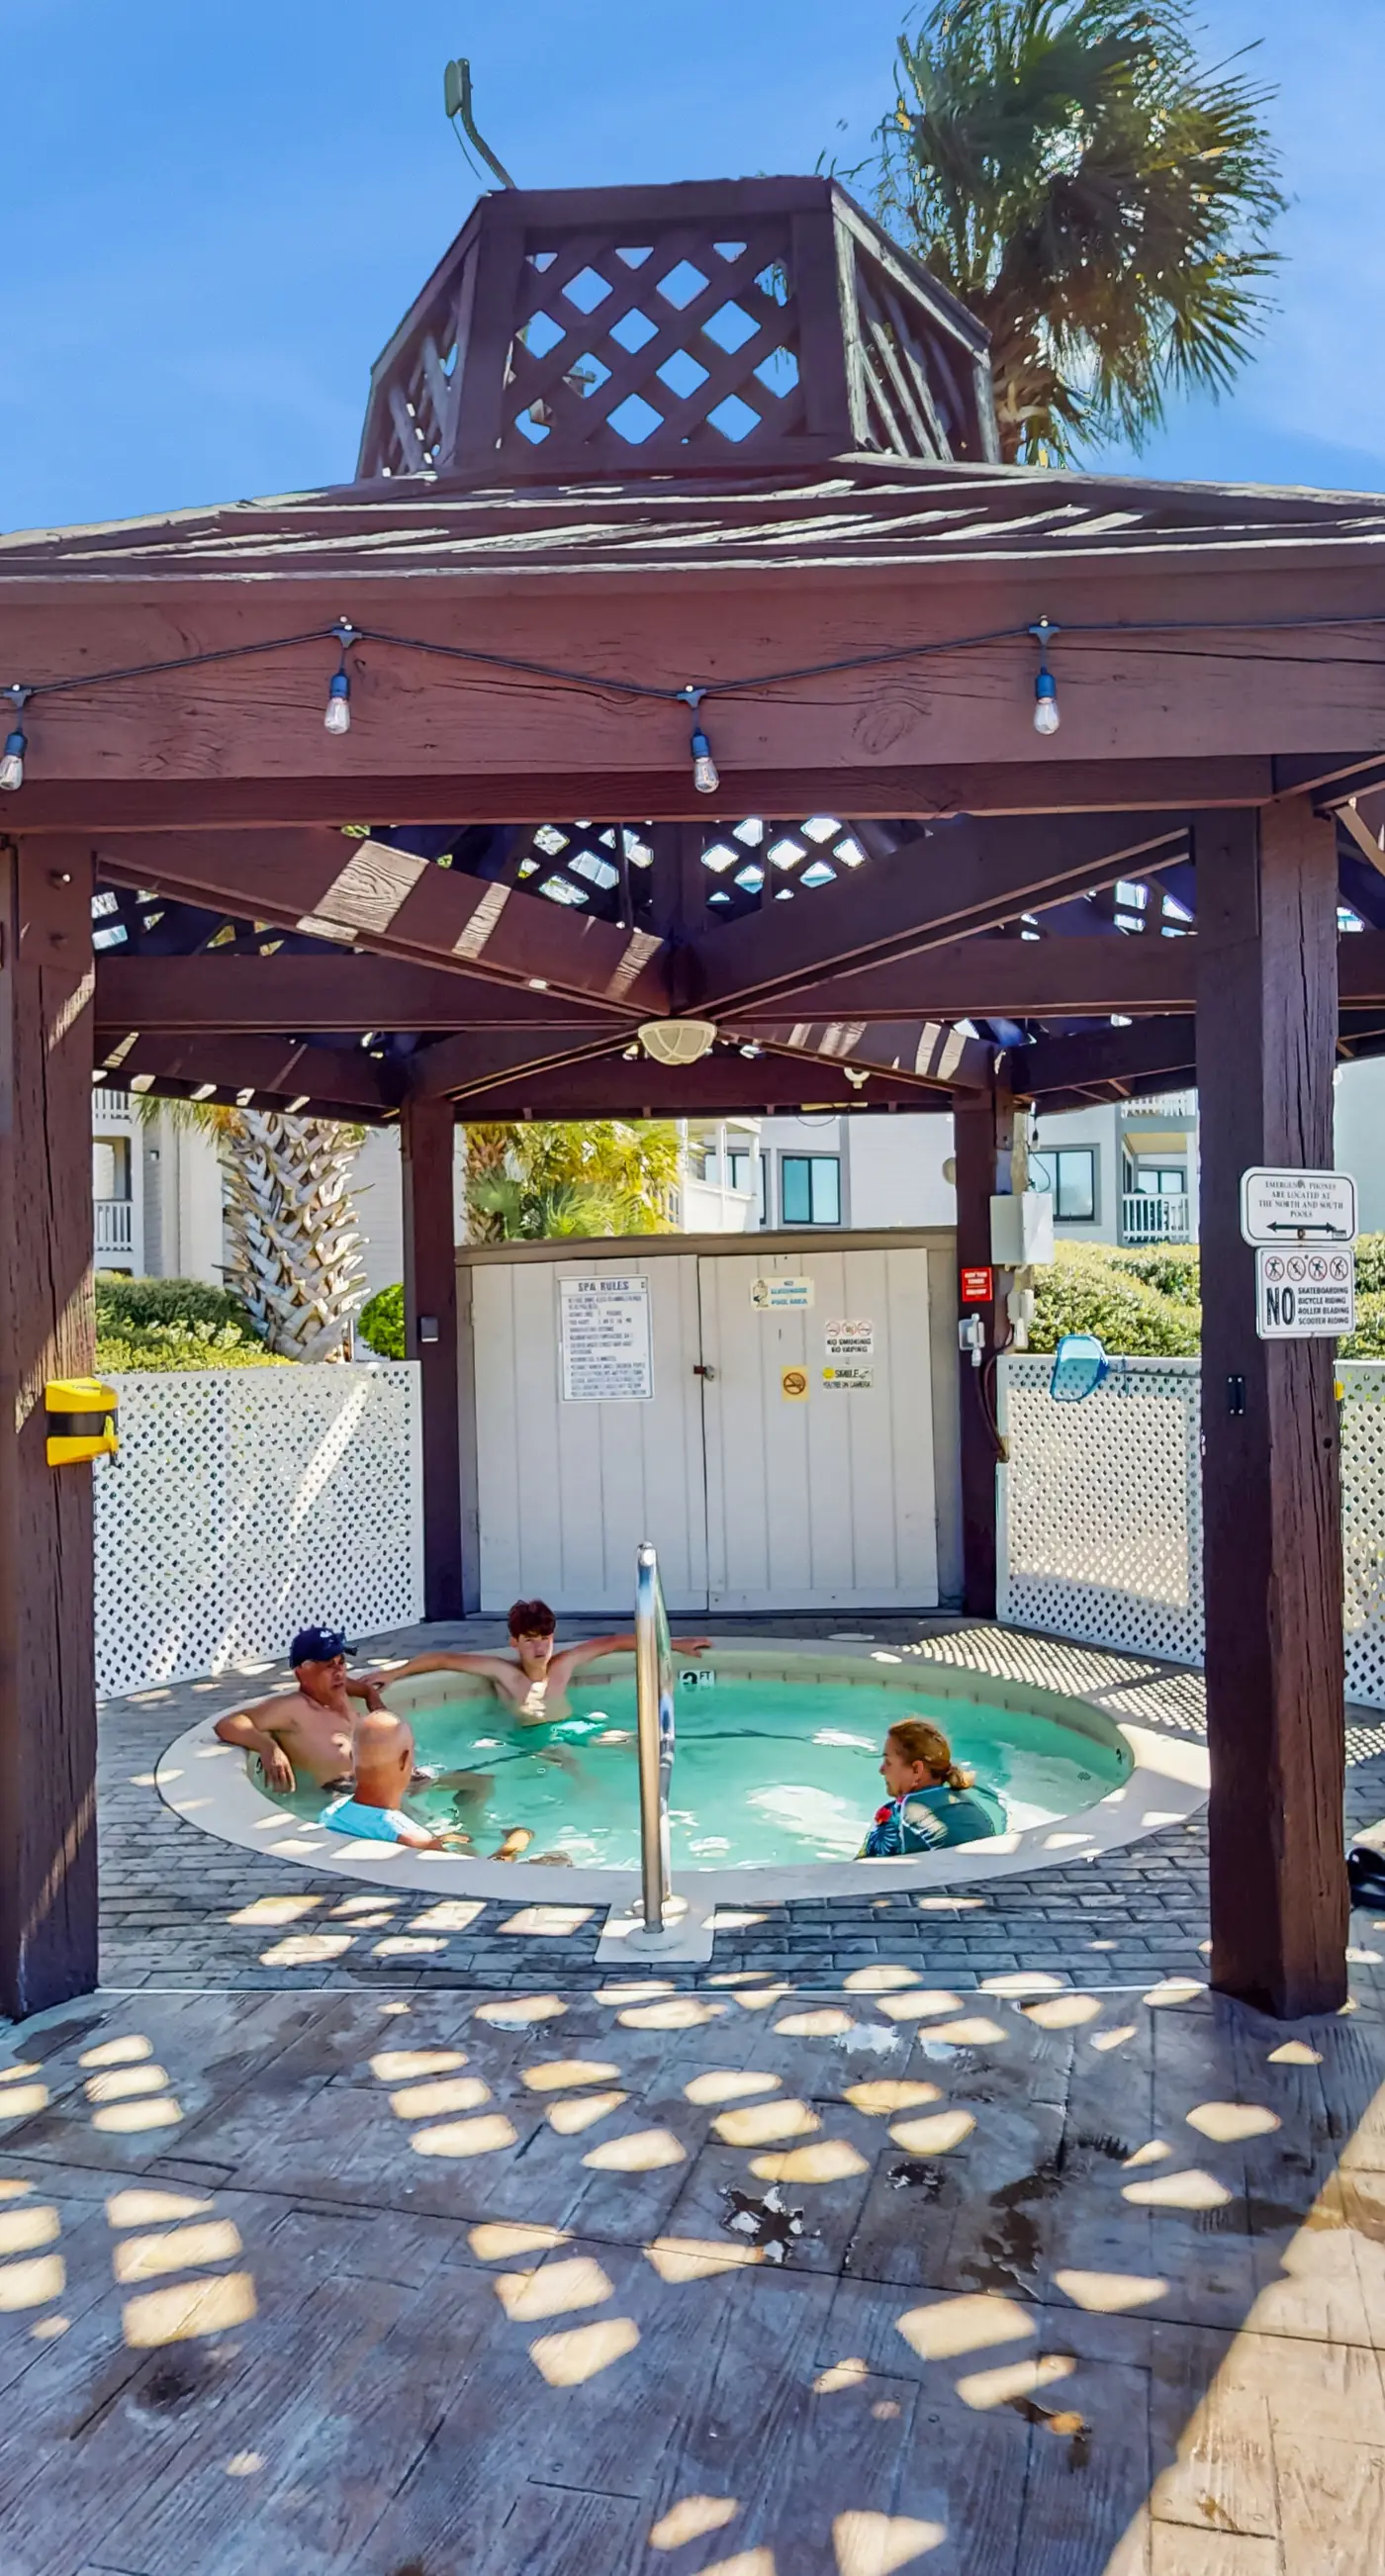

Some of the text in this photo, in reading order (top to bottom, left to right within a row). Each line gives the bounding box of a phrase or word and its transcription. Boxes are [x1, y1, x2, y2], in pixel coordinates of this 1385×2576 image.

[1265, 1180, 1306, 1189] EMERGENY
[578, 1281, 629, 1292] SPA RULES
[1266, 1286, 1295, 1326] NO
[835, 1369, 859, 1378] SMILE
[699, 1671, 710, 1680] FT
